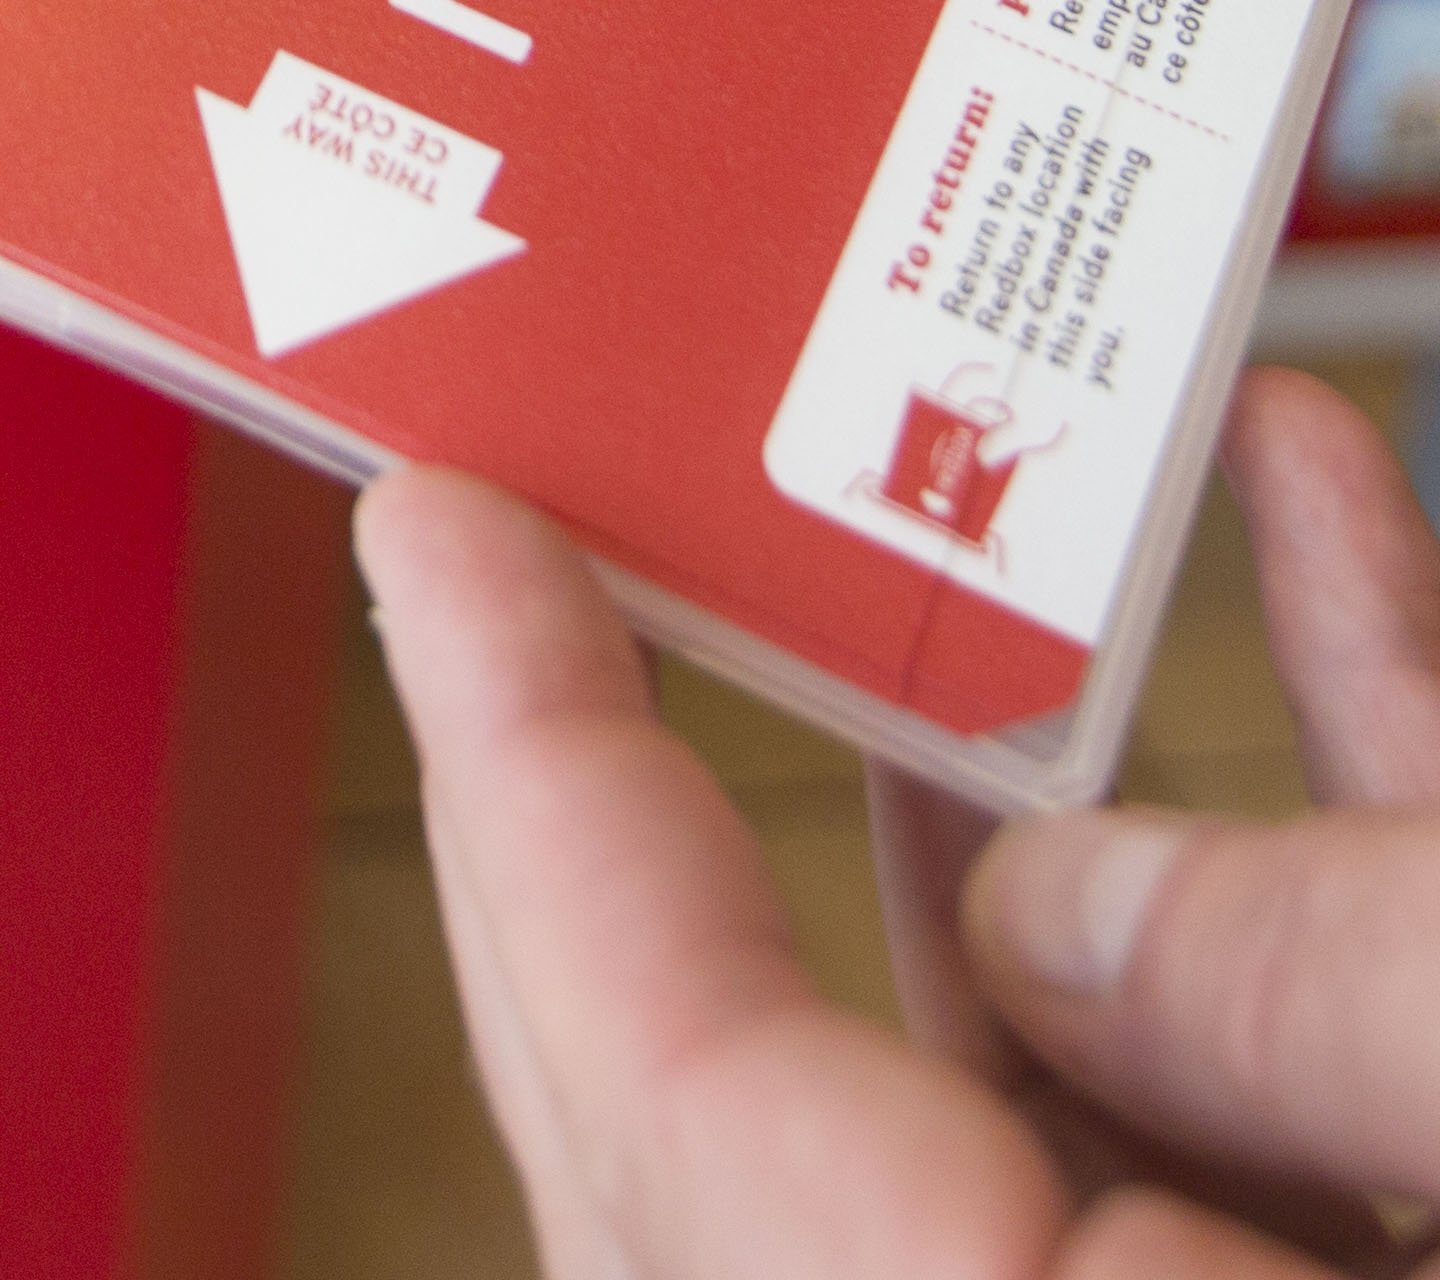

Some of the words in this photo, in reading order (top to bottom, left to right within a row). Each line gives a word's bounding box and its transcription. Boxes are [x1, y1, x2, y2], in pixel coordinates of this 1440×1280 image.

[1127, 34, 1152, 68] au
[1164, 54, 1188, 84] ce
[283, 115, 354, 164] WAY
[1074, 137, 1110, 199] with
[364, 151, 437, 206] THIS
[885, 244, 932, 296] To
[922, 85, 995, 235] return:
[1093, 148, 1153, 236] facing
[940, 220, 999, 318] Return
[985, 183, 1014, 210] to
[1005, 124, 1041, 174] any
[975, 227, 1036, 334] Redbox
[1021, 106, 1083, 217] location
[1025, 205, 1084, 314] Canada
[1076, 246, 1111, 304] side
[1013, 322, 1042, 355] in
[1048, 316, 1086, 368] this
